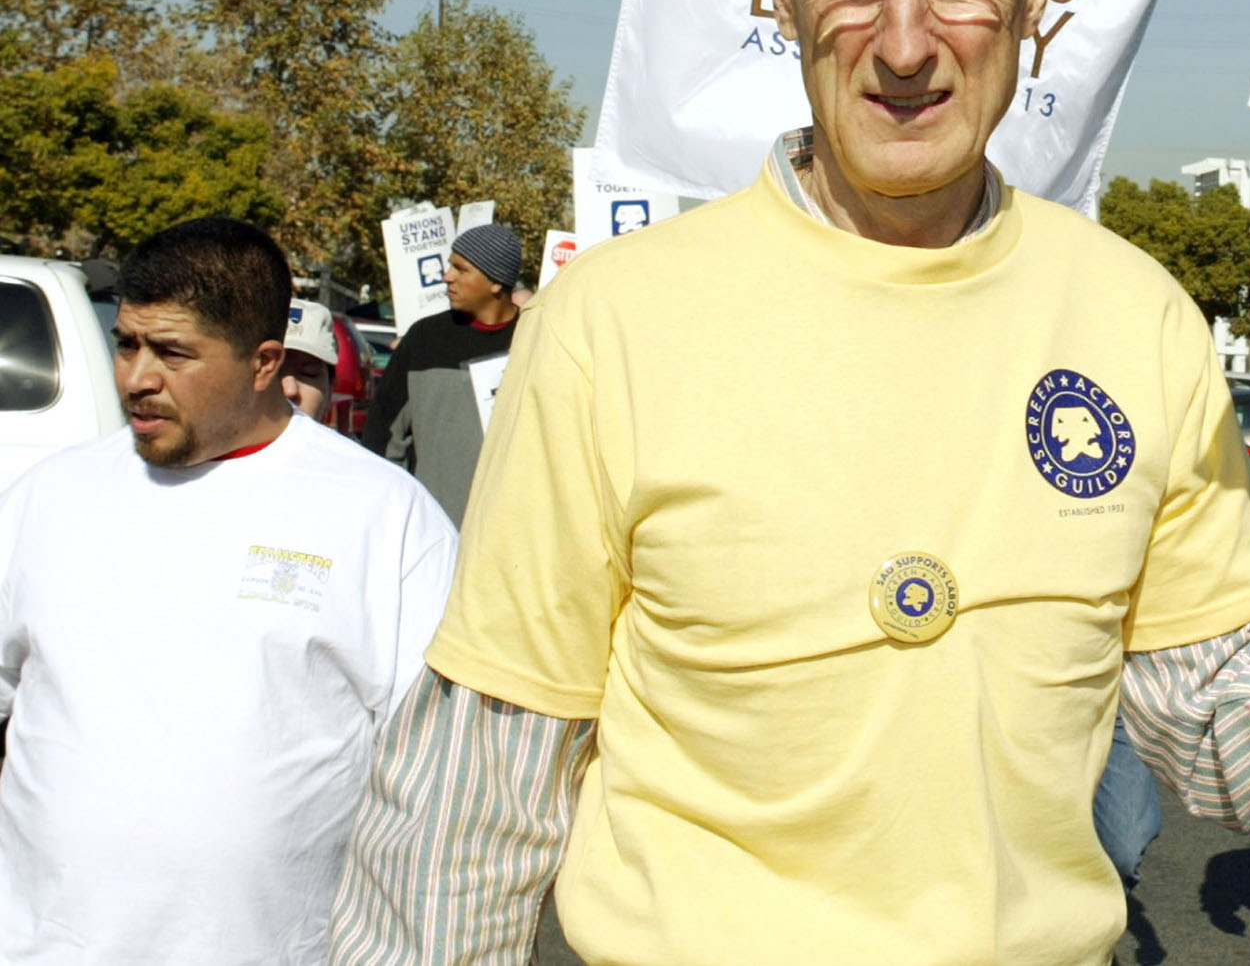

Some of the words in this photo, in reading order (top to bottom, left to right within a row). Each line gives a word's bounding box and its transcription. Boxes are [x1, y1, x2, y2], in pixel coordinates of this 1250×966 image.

[400, 216, 443, 233] UNIONS
[401, 227, 446, 245] STAND
[403, 238, 447, 253] TOGETHER
[1029, 376, 1055, 460] SCREEN
[1075, 377, 1132, 455] ACTORS
[1055, 470, 1117, 493] GUILD
[896, 556, 948, 579] SUPPORTS
[945, 580, 956, 617] LABOR
